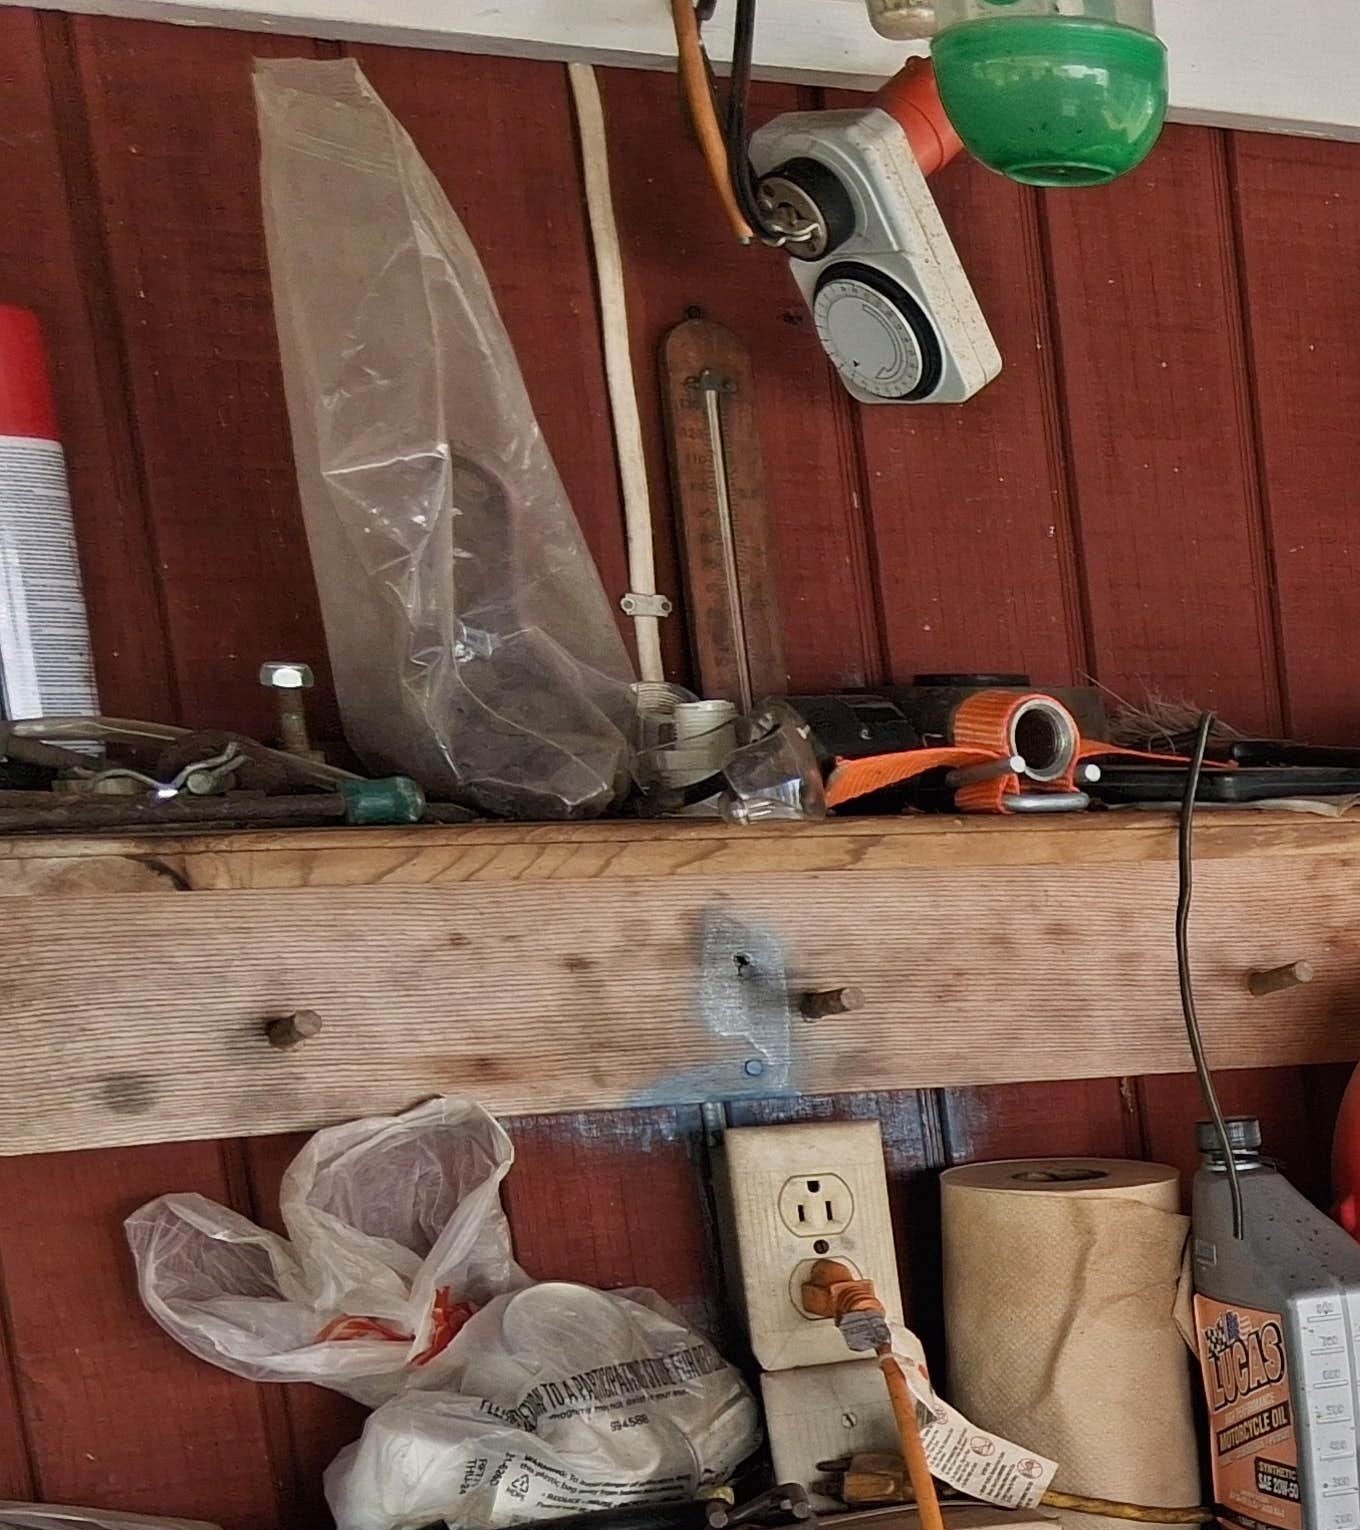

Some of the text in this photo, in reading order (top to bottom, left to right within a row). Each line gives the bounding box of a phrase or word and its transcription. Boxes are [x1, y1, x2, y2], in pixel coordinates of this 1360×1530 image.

[1207, 1320, 1284, 1408] LUCAS
[1220, 1414, 1270, 1451] MOTORCYCLE
[1272, 1405, 1288, 1426] OIL
[1258, 1473, 1299, 1498] SAE 20W-50
[1259, 1461, 1296, 1480] SYNTHETIC
